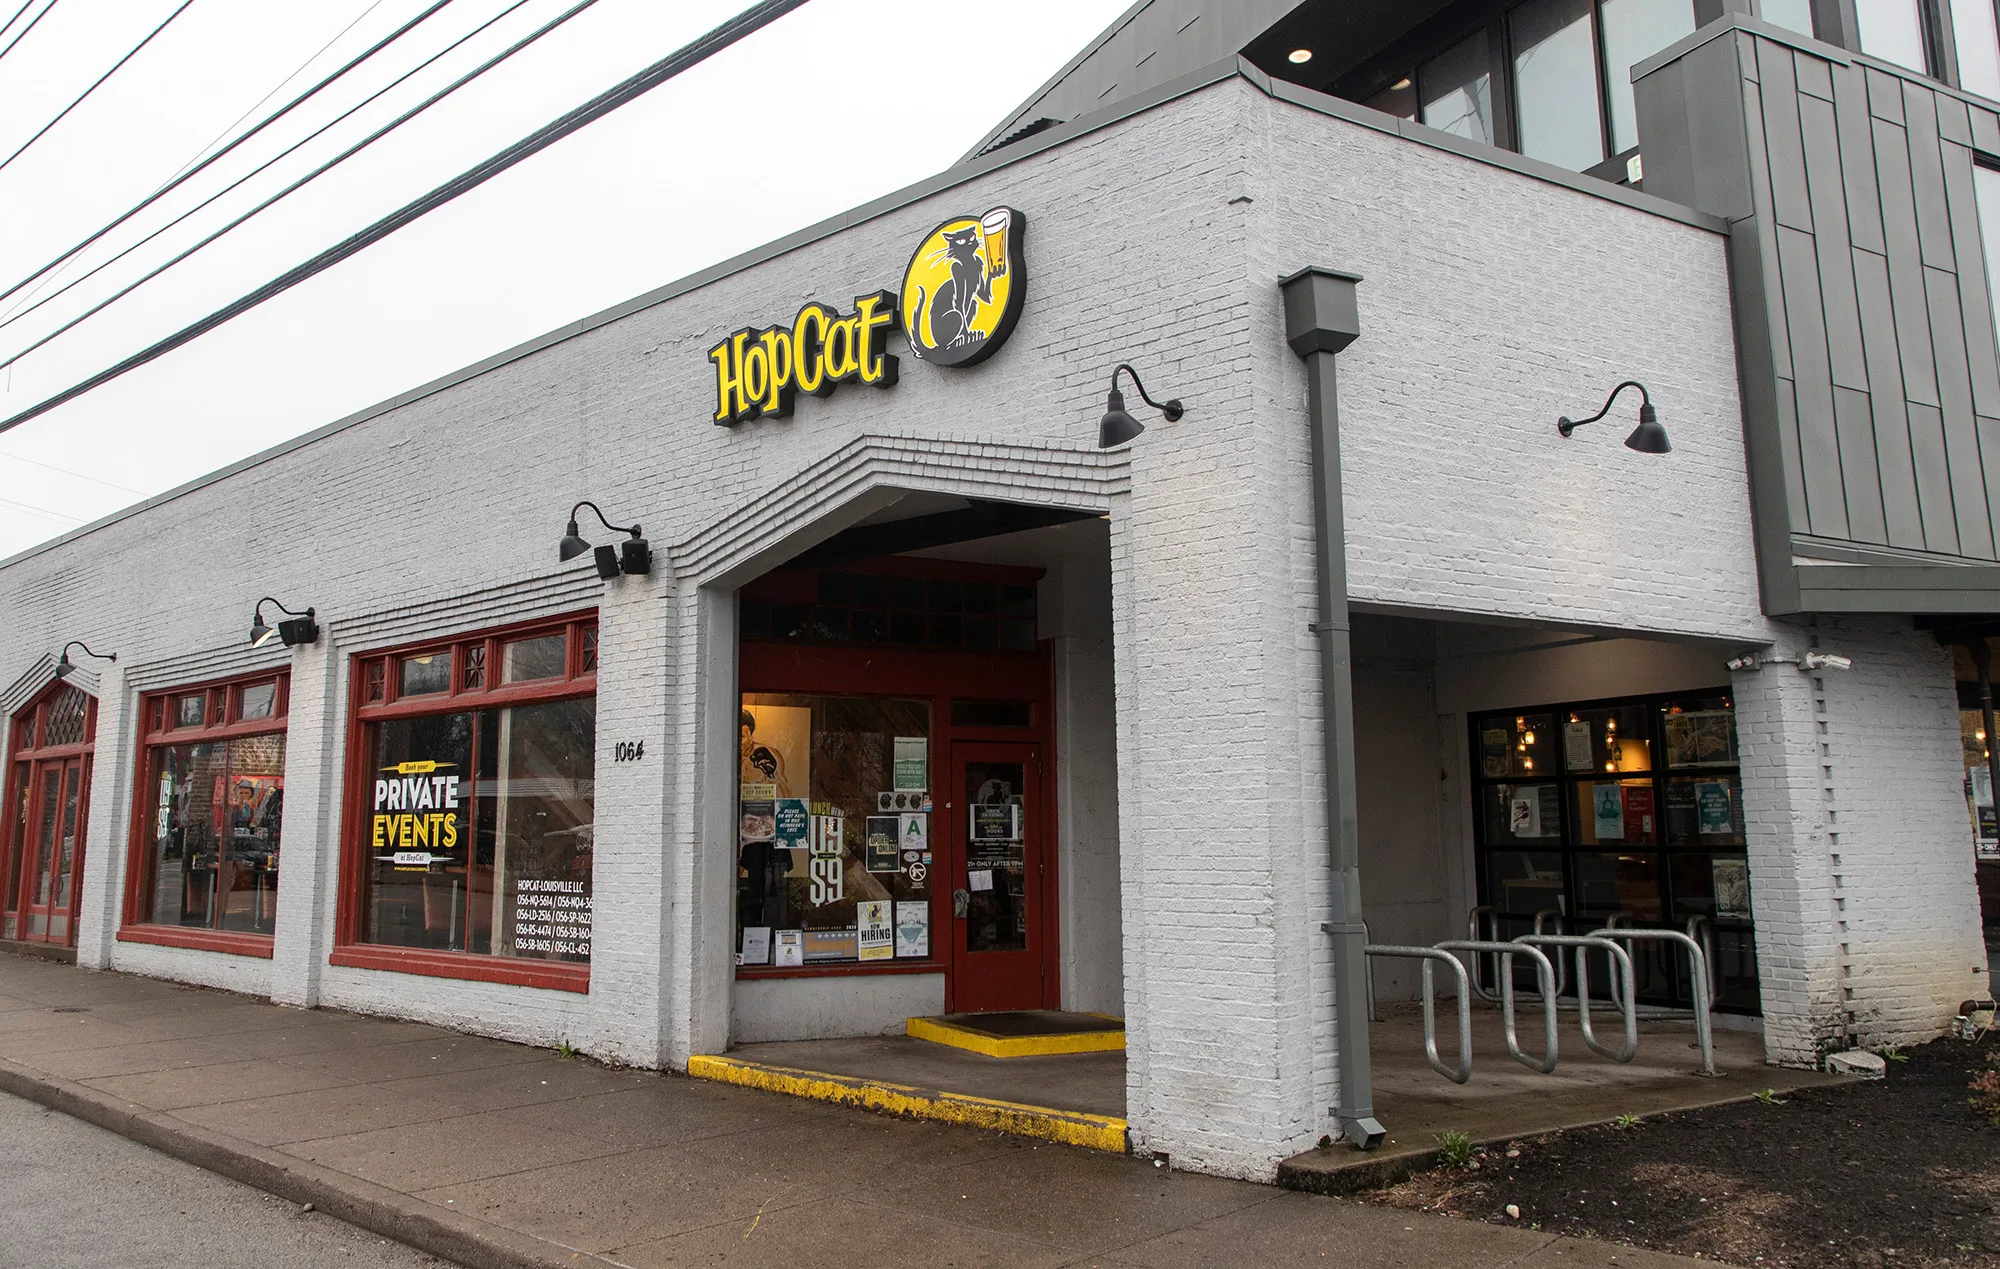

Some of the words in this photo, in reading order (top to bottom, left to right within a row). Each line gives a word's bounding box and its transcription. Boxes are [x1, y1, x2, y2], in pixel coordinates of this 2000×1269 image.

[709, 293, 892, 424] HopCat
[615, 740, 644, 762] 1064
[374, 776, 459, 811] PRIVATE
[372, 813, 457, 848] EVENTS
[906, 819, 921, 836] A
[878, 844, 898, 853] ONLINE
[406, 854, 424, 862] HopCat
[518, 880, 573, 892] HOPCAT-LOUISVILLE
[573, 881, 584, 893] LLC
[517, 895, 553, 907] 056-NQ-5614
[516, 909, 551, 921] 056-LD-2516
[555, 911, 592, 924] 056-SP-1622
[861, 928, 891, 941] HIRING
[515, 938, 551, 951] 056-SB-1605
